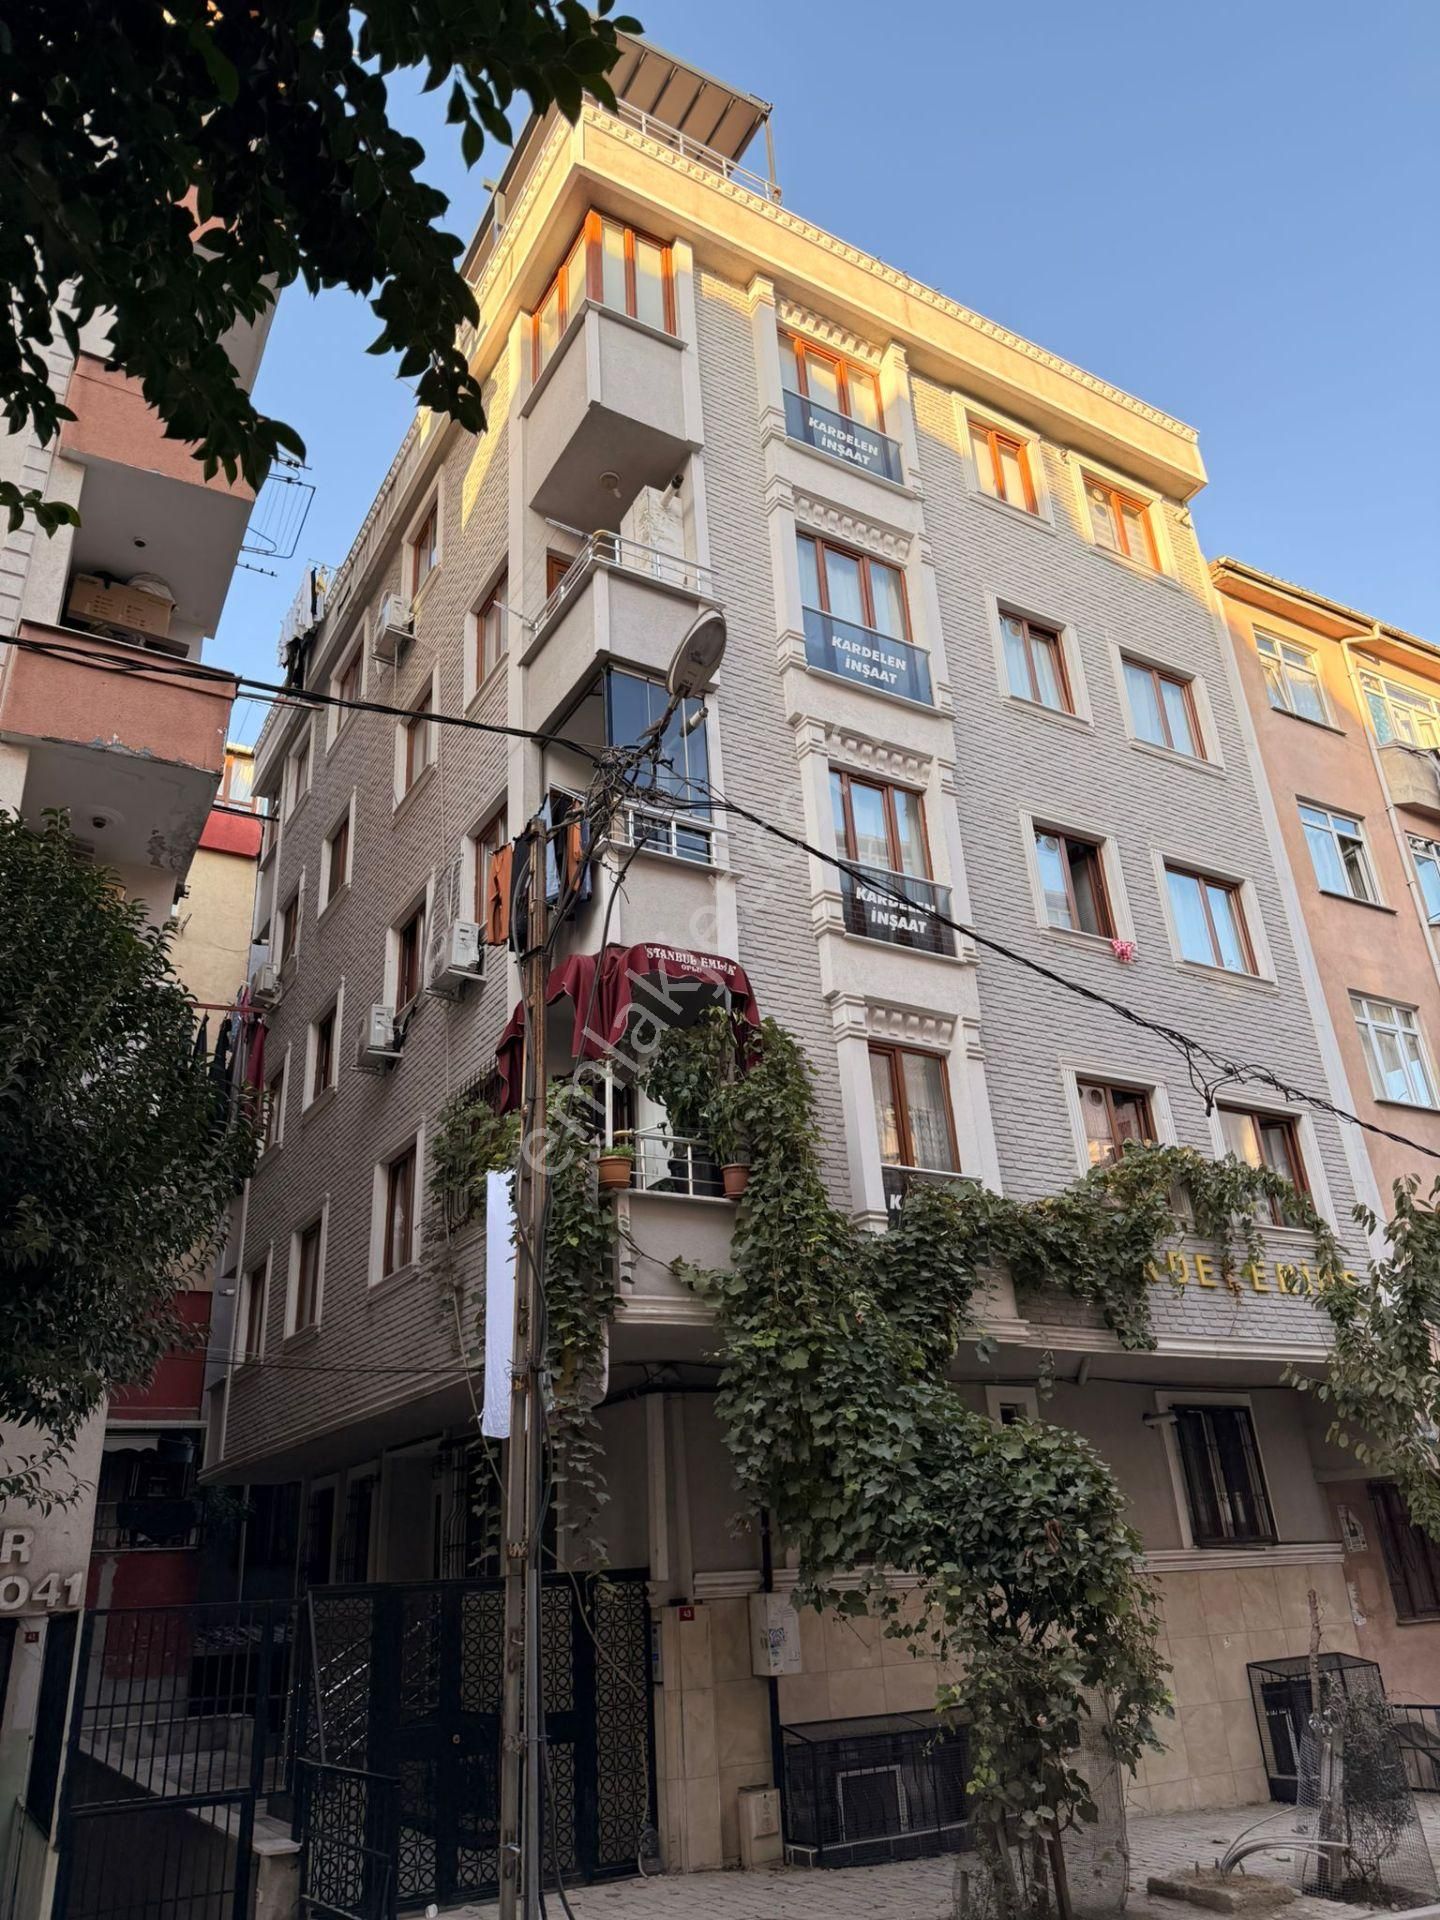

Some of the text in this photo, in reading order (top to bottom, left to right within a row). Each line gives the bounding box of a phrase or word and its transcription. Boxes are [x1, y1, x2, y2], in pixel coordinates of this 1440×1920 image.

[808, 417, 878, 456] KARDELEN
[821, 435, 870, 465] İNŞAAT
[832, 636, 907, 671] KARDELEN
[845, 655, 897, 684] İNŞAAT
[870, 907, 927, 934] İNŞAAT
